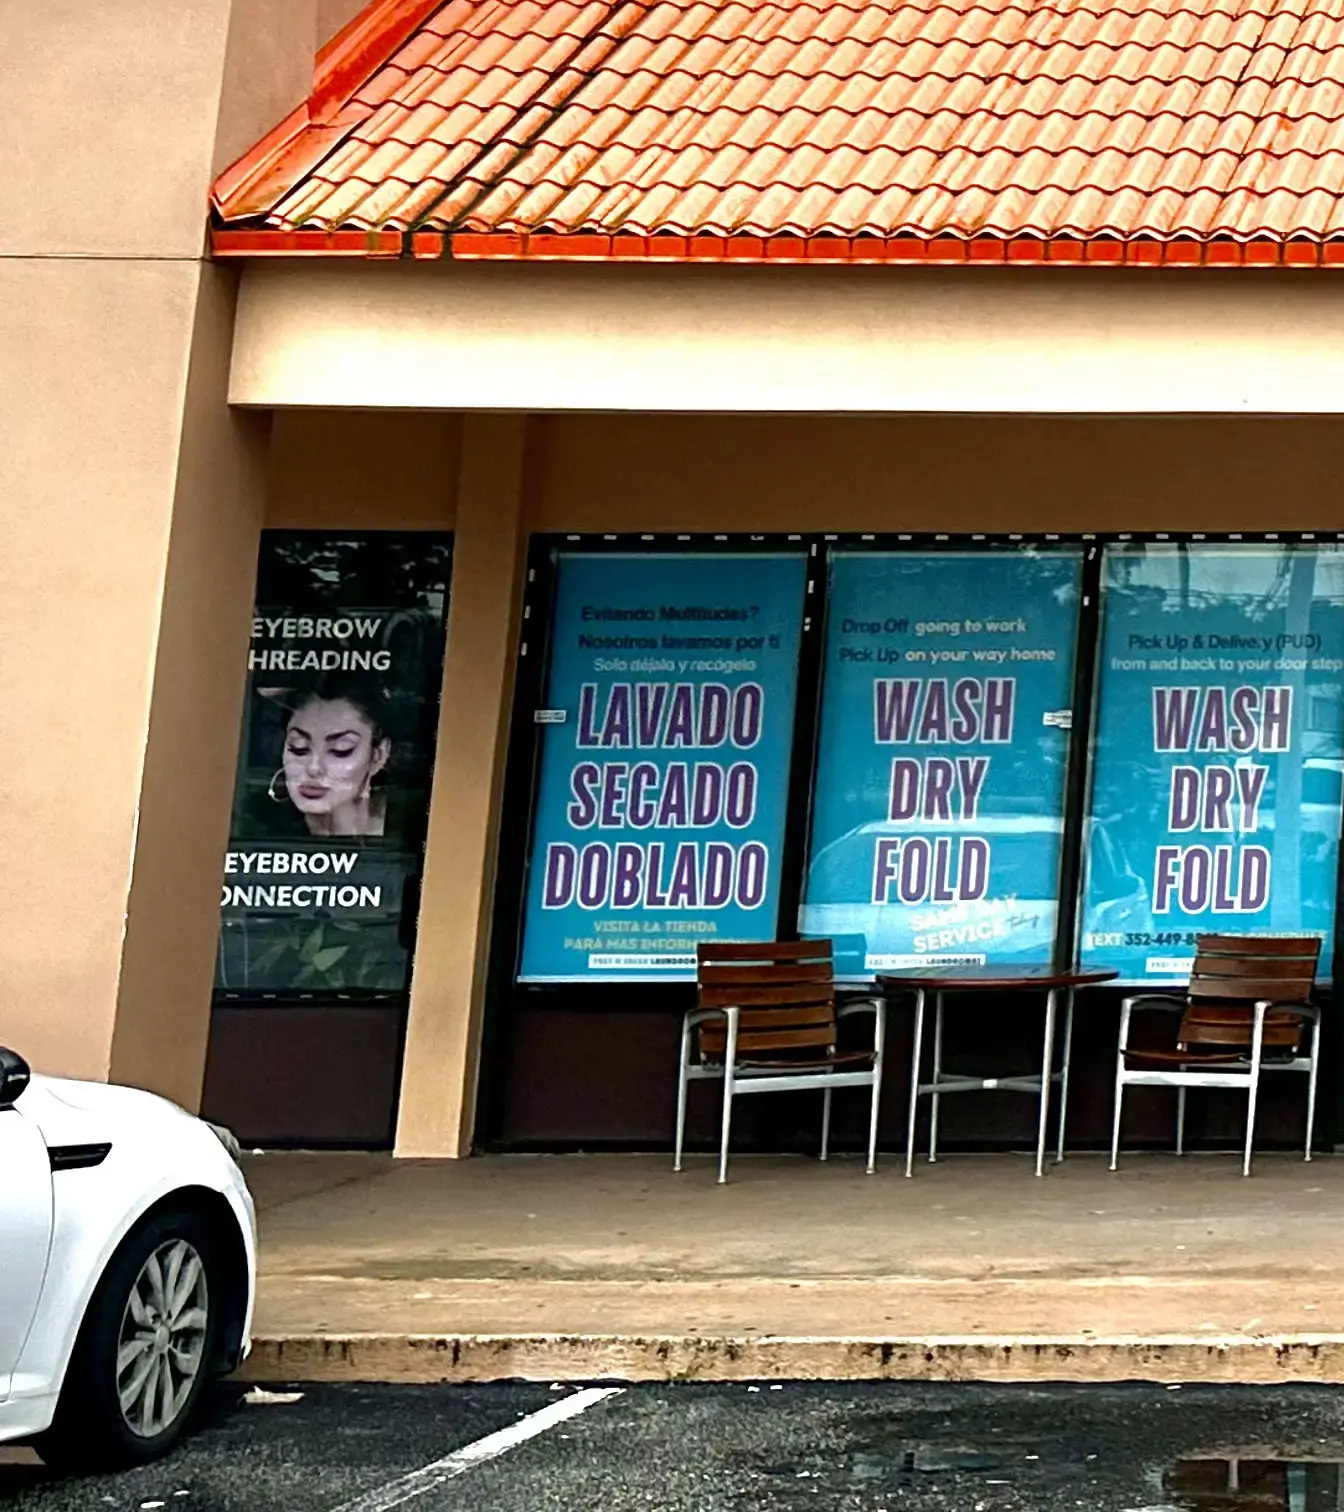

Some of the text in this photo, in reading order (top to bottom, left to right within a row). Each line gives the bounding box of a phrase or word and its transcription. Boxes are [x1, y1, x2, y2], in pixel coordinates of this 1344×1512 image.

[251, 618, 382, 639] EYEBROW
[842, 617, 1026, 636] Drop Off going to work
[1128, 634, 1162, 650] Pick
[1166, 634, 1188, 653] Up
[1192, 635, 1204, 650] &
[1208, 634, 1273, 653] Delivery
[248, 650, 392, 672] HREADING
[838, 646, 1056, 665] Pick Up on your way home
[1149, 656, 1178, 671] and
[1181, 656, 1217, 671] back
[1219, 656, 1235, 671] to
[1237, 659, 1270, 674] your
[1273, 656, 1308, 671] door
[576, 682, 764, 749] LAVADO
[874, 677, 1016, 745] WASH
[1152, 685, 1293, 753] WASH
[567, 761, 758, 829] SECADO
[888, 756, 991, 824] DRY
[1168, 765, 1269, 833] DRY
[224, 852, 358, 874] EYEBROW
[542, 841, 768, 910] DOBLADO
[871, 836, 991, 906] FOLD
[1152, 844, 1270, 914] FOLD
[220, 885, 381, 907] ONNECTION
[913, 919, 1007, 953] SERVICE
[1124, 932, 1217, 947] 352-449-8
